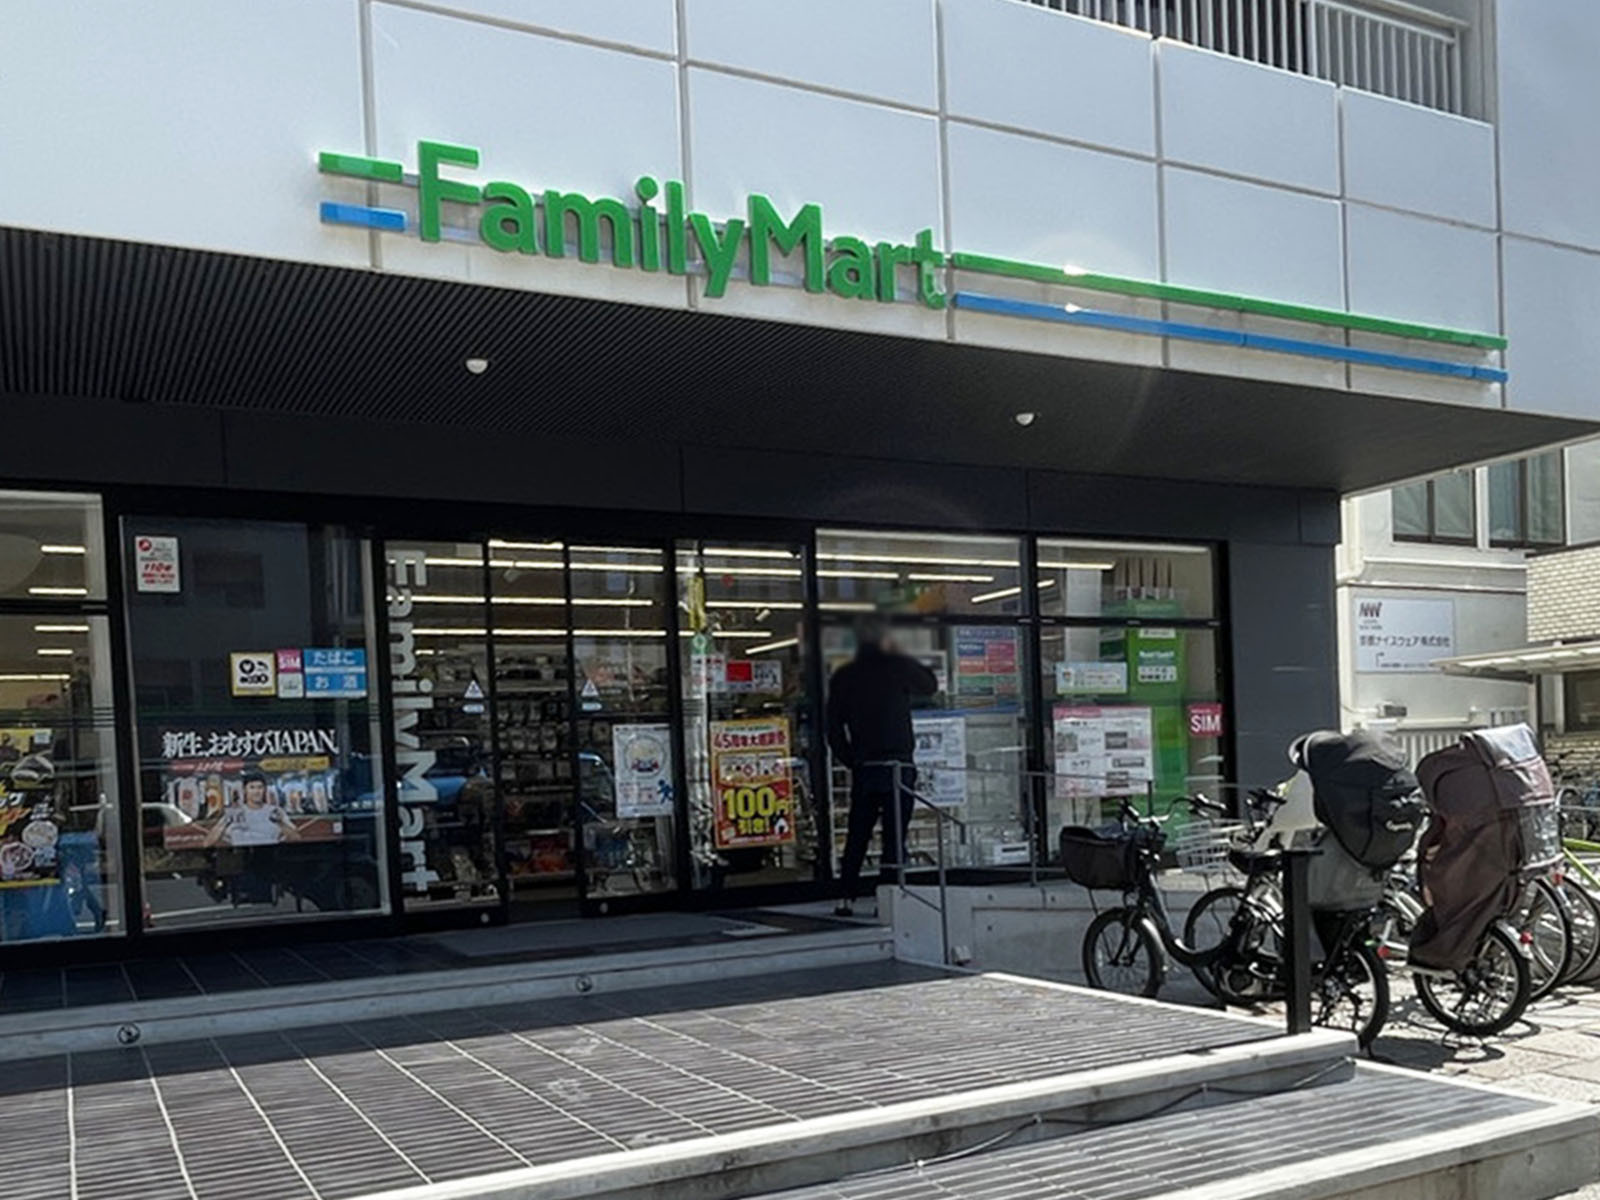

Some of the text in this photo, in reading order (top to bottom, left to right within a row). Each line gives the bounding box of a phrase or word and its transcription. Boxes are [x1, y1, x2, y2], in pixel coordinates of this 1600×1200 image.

[417, 140, 947, 310] FamilyMart
[313, 650, 357, 667] たばこ
[385, 549, 442, 893] FamilyMart
[1190, 713, 1222, 733] SIM
